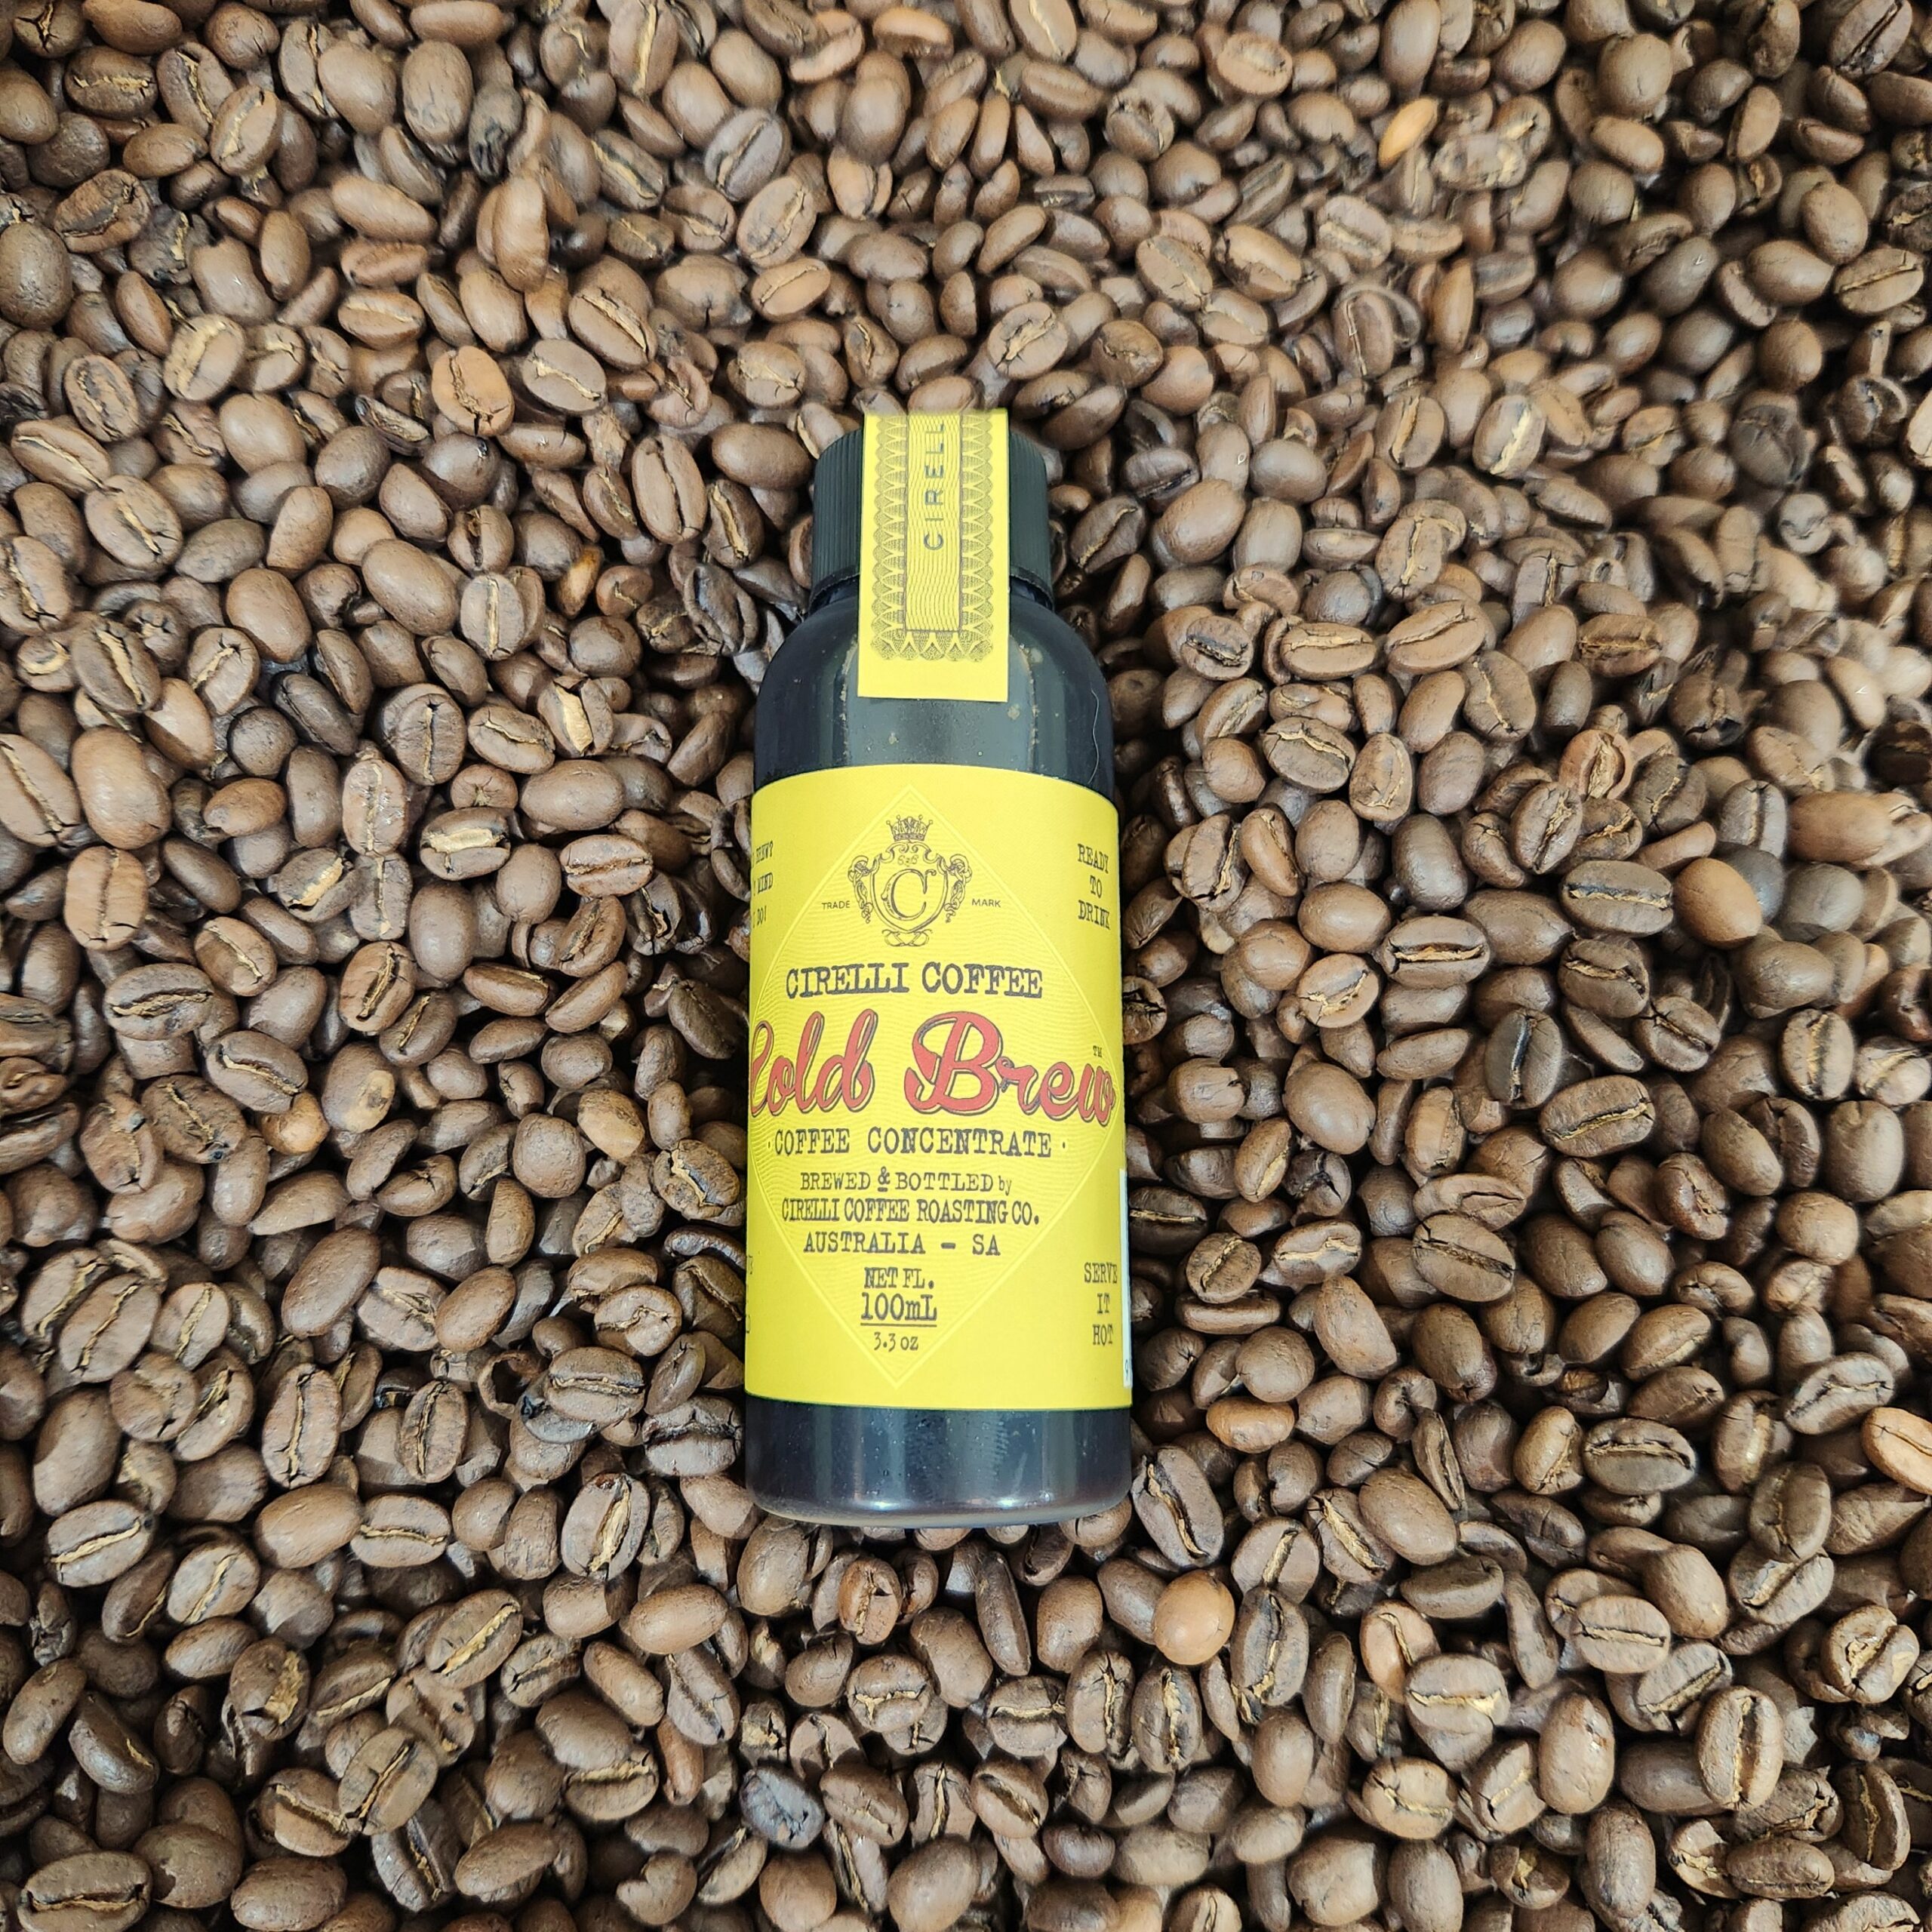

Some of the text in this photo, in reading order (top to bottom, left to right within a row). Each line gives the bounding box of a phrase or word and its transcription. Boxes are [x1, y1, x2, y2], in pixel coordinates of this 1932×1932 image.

[1077, 843, 1109, 875] READY
[1089, 875, 1103, 899] TO
[821, 898, 1001, 909] TRADE MARK
[1078, 899, 1111, 931] DRINK
[786, 961, 1043, 1000] CIRELLI COFFEE
[904, 1011, 1117, 1128] Brew
[1092, 1044, 1103, 1058] TM
[774, 1125, 1052, 1158] COFFEE CONCENTRATE
[800, 1165, 1012, 1197] BREWED & BOTTLED by
[781, 1196, 1040, 1226] CIRELLI COFFEE ROASTING CO.
[802, 1230, 926, 1255] AUSTRALIA
[971, 1233, 1001, 1257] SA
[863, 1266, 934, 1290] NET FL.
[1084, 1261, 1118, 1284] SERVE
[860, 1291, 938, 1322] 100mL
[1097, 1292, 1110, 1315] IT
[874, 1331, 919, 1353] 3.3 oz
[1092, 1323, 1113, 1347] HOT
